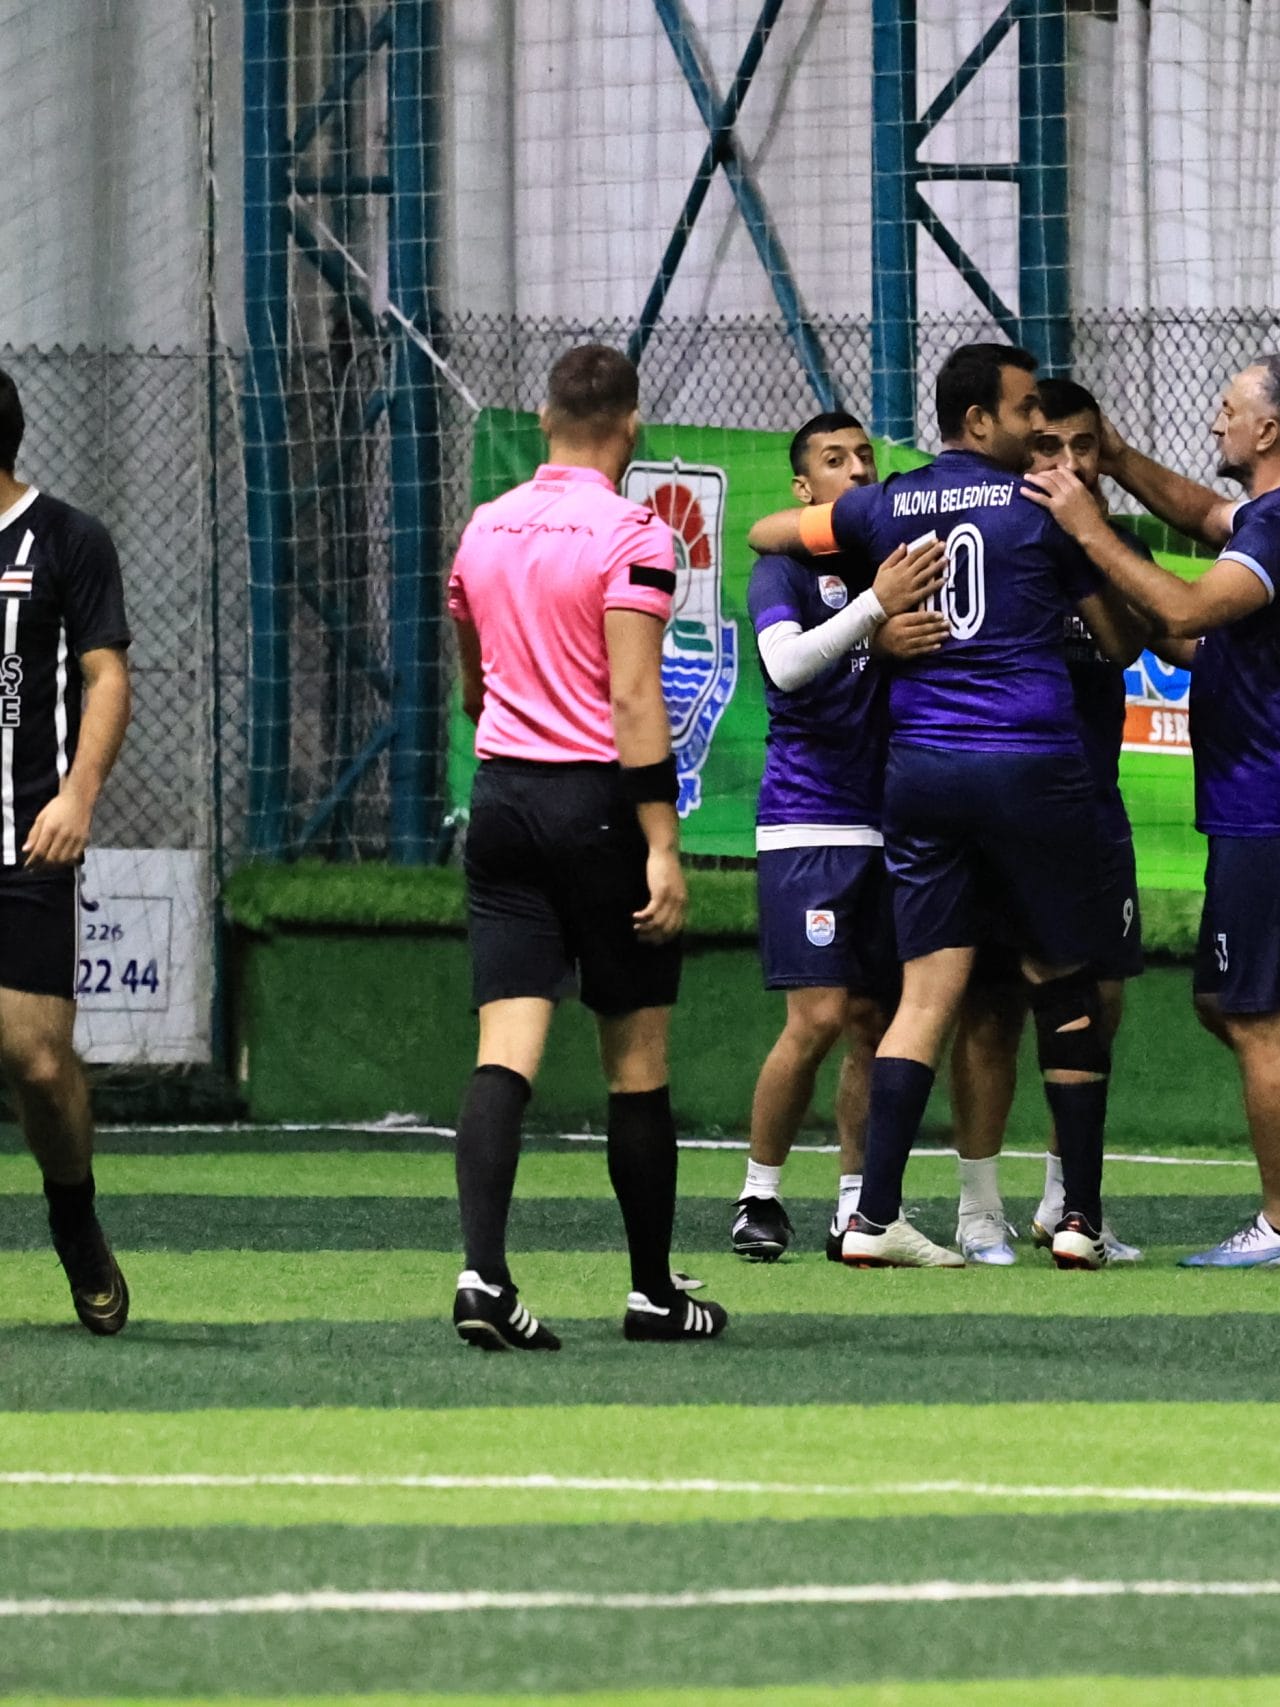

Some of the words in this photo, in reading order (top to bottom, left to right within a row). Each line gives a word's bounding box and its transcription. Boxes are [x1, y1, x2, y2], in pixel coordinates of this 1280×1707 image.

[892, 490, 937, 517] YALOVA
[940, 481, 1014, 513] BELEDİYESİ
[1149, 711, 1190, 744] SER
[1123, 898, 1134, 937] 9
[120, 959, 159, 994] 44
